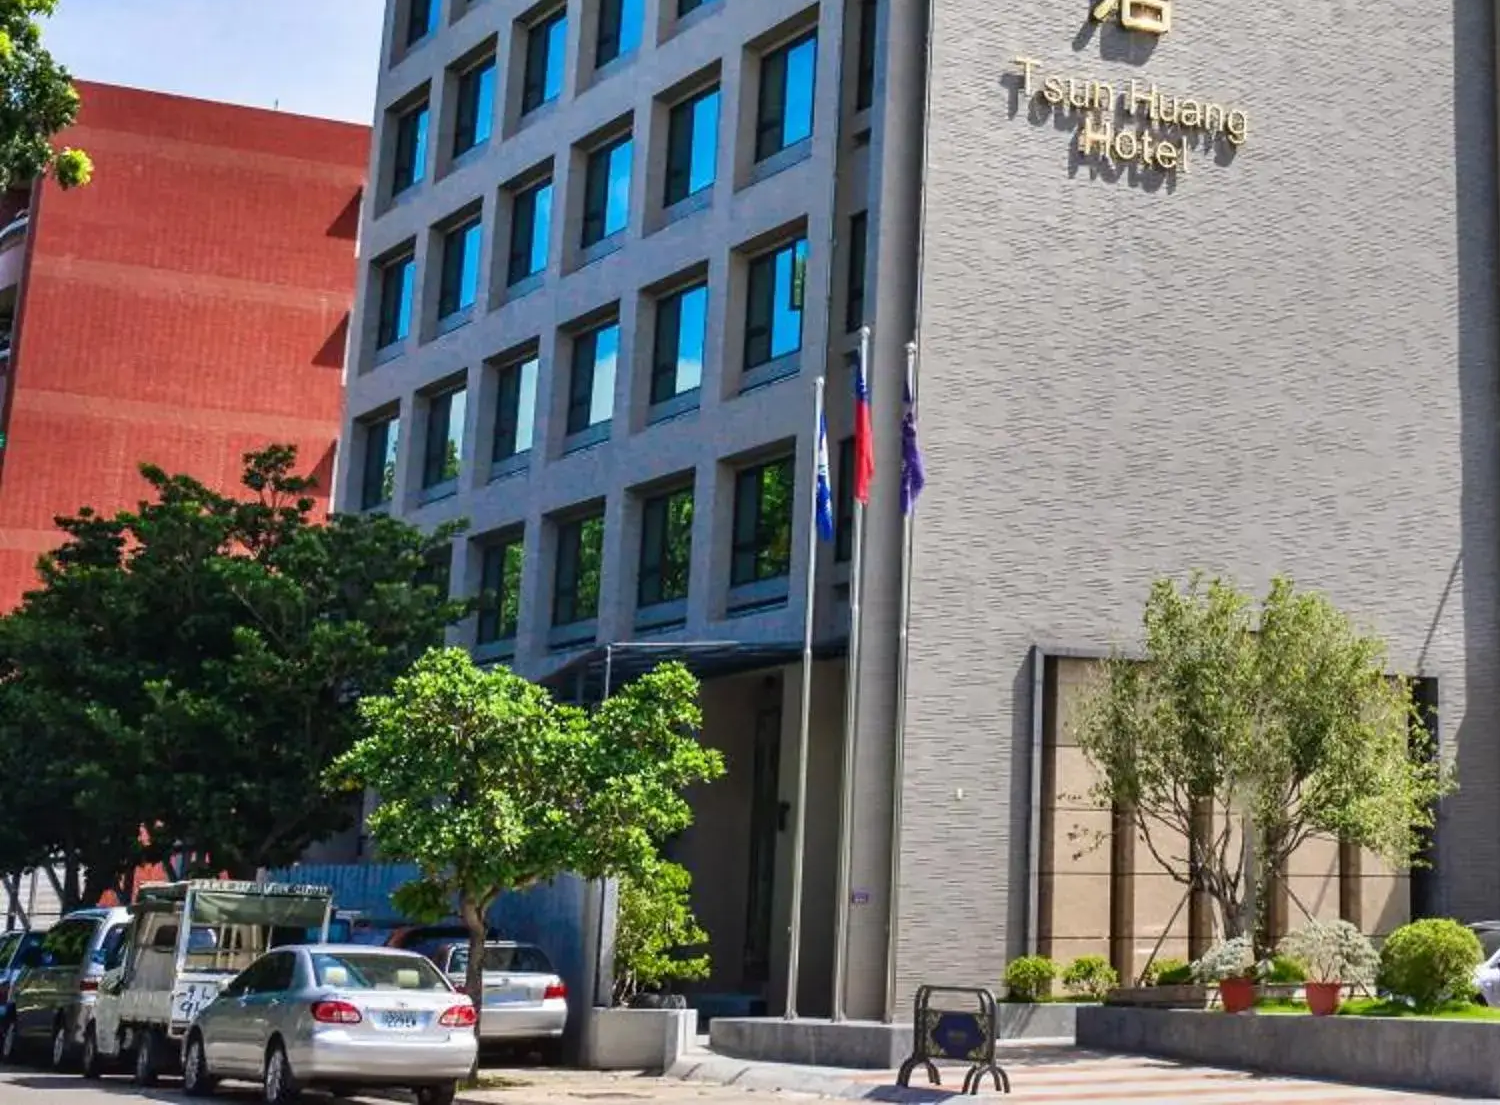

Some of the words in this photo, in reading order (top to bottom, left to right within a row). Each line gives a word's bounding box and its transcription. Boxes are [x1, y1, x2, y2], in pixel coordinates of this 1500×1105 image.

[1009, 56, 1115, 113] Tsun
[1129, 77, 1249, 145] Huang
[1082, 114, 1190, 173] Hotel
